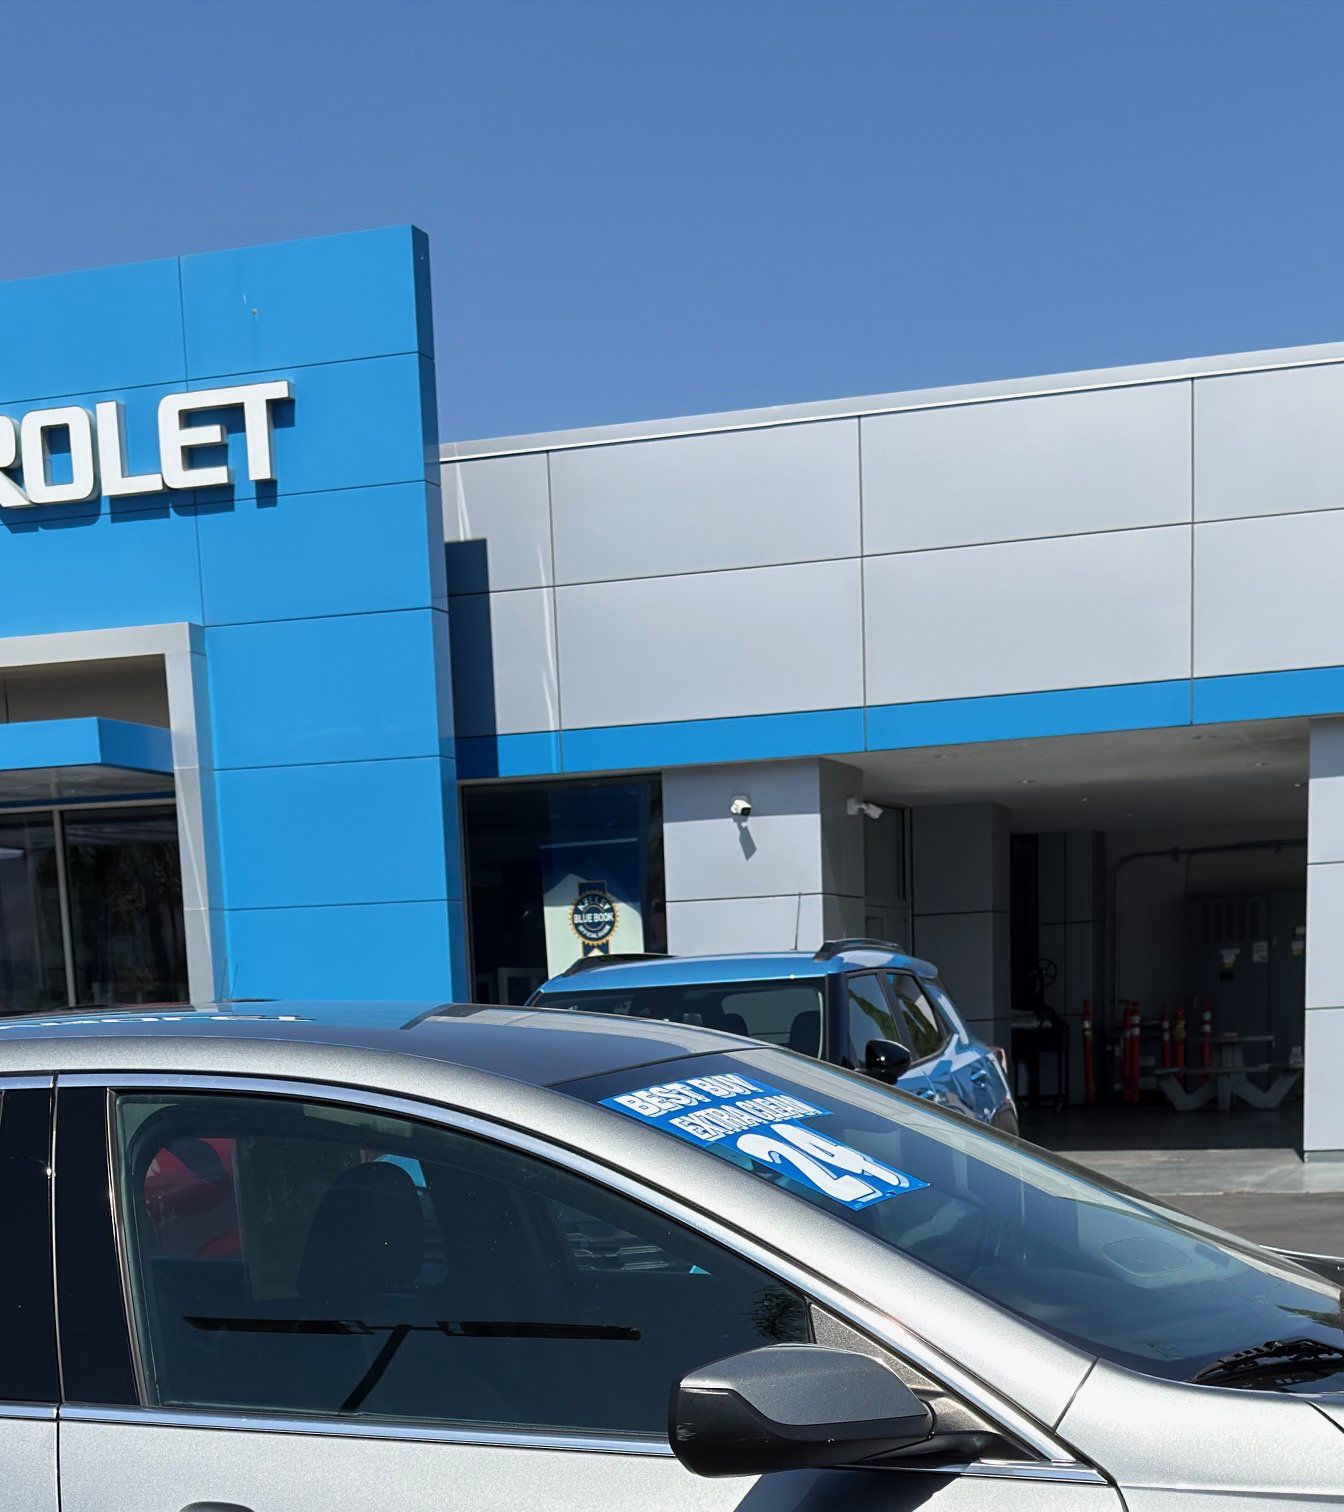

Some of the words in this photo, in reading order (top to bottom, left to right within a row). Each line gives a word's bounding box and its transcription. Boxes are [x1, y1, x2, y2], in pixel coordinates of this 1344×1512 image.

[573, 913, 593, 924] BLUE
[593, 912, 614, 923] BOOK
[613, 1082, 712, 1118] BEST
[686, 1074, 764, 1099] BUY
[669, 1105, 770, 1142] EXTRA
[736, 1095, 823, 1122] CLEAN
[737, 1123, 910, 1203] 24
